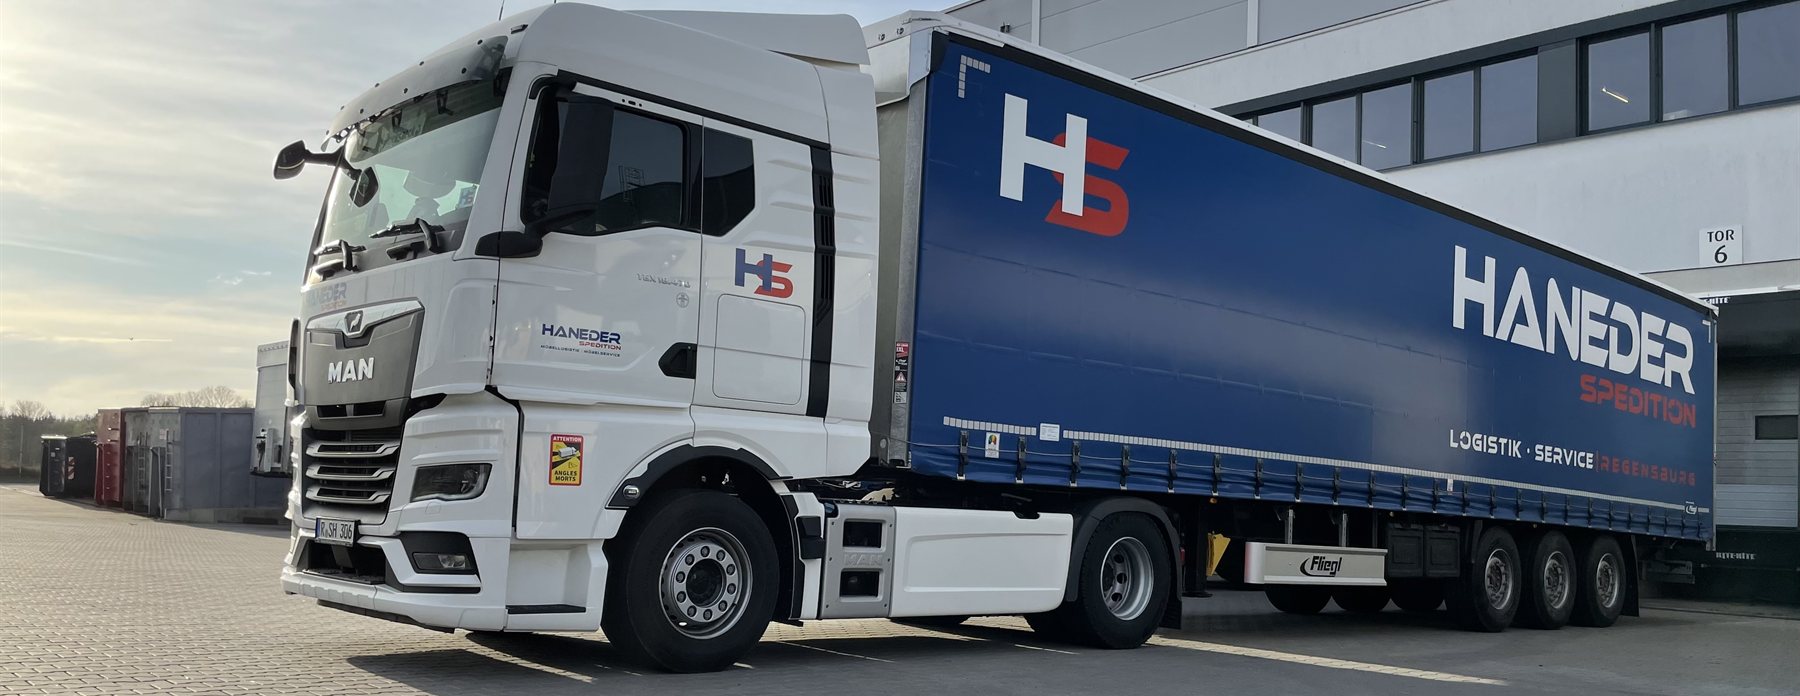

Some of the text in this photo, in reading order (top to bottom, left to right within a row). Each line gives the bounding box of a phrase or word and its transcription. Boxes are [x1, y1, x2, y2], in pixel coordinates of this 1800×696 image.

[1000, 93, 1130, 237] HS
[1706, 229, 1735, 243] TOR
[1714, 244, 1728, 264] 6
[734, 247, 794, 299] HS
[1452, 245, 1696, 395] HANEDER
[541, 323, 621, 345] HANEDER
[579, 340, 622, 351] SPEDITION
[327, 357, 375, 384] MAN
[1580, 374, 1696, 428] SPEDITION
[1450, 429, 1696, 486] LOGISTIK SERVICE REGENSBURG
[1310, 555, 1343, 575] Fliegl
